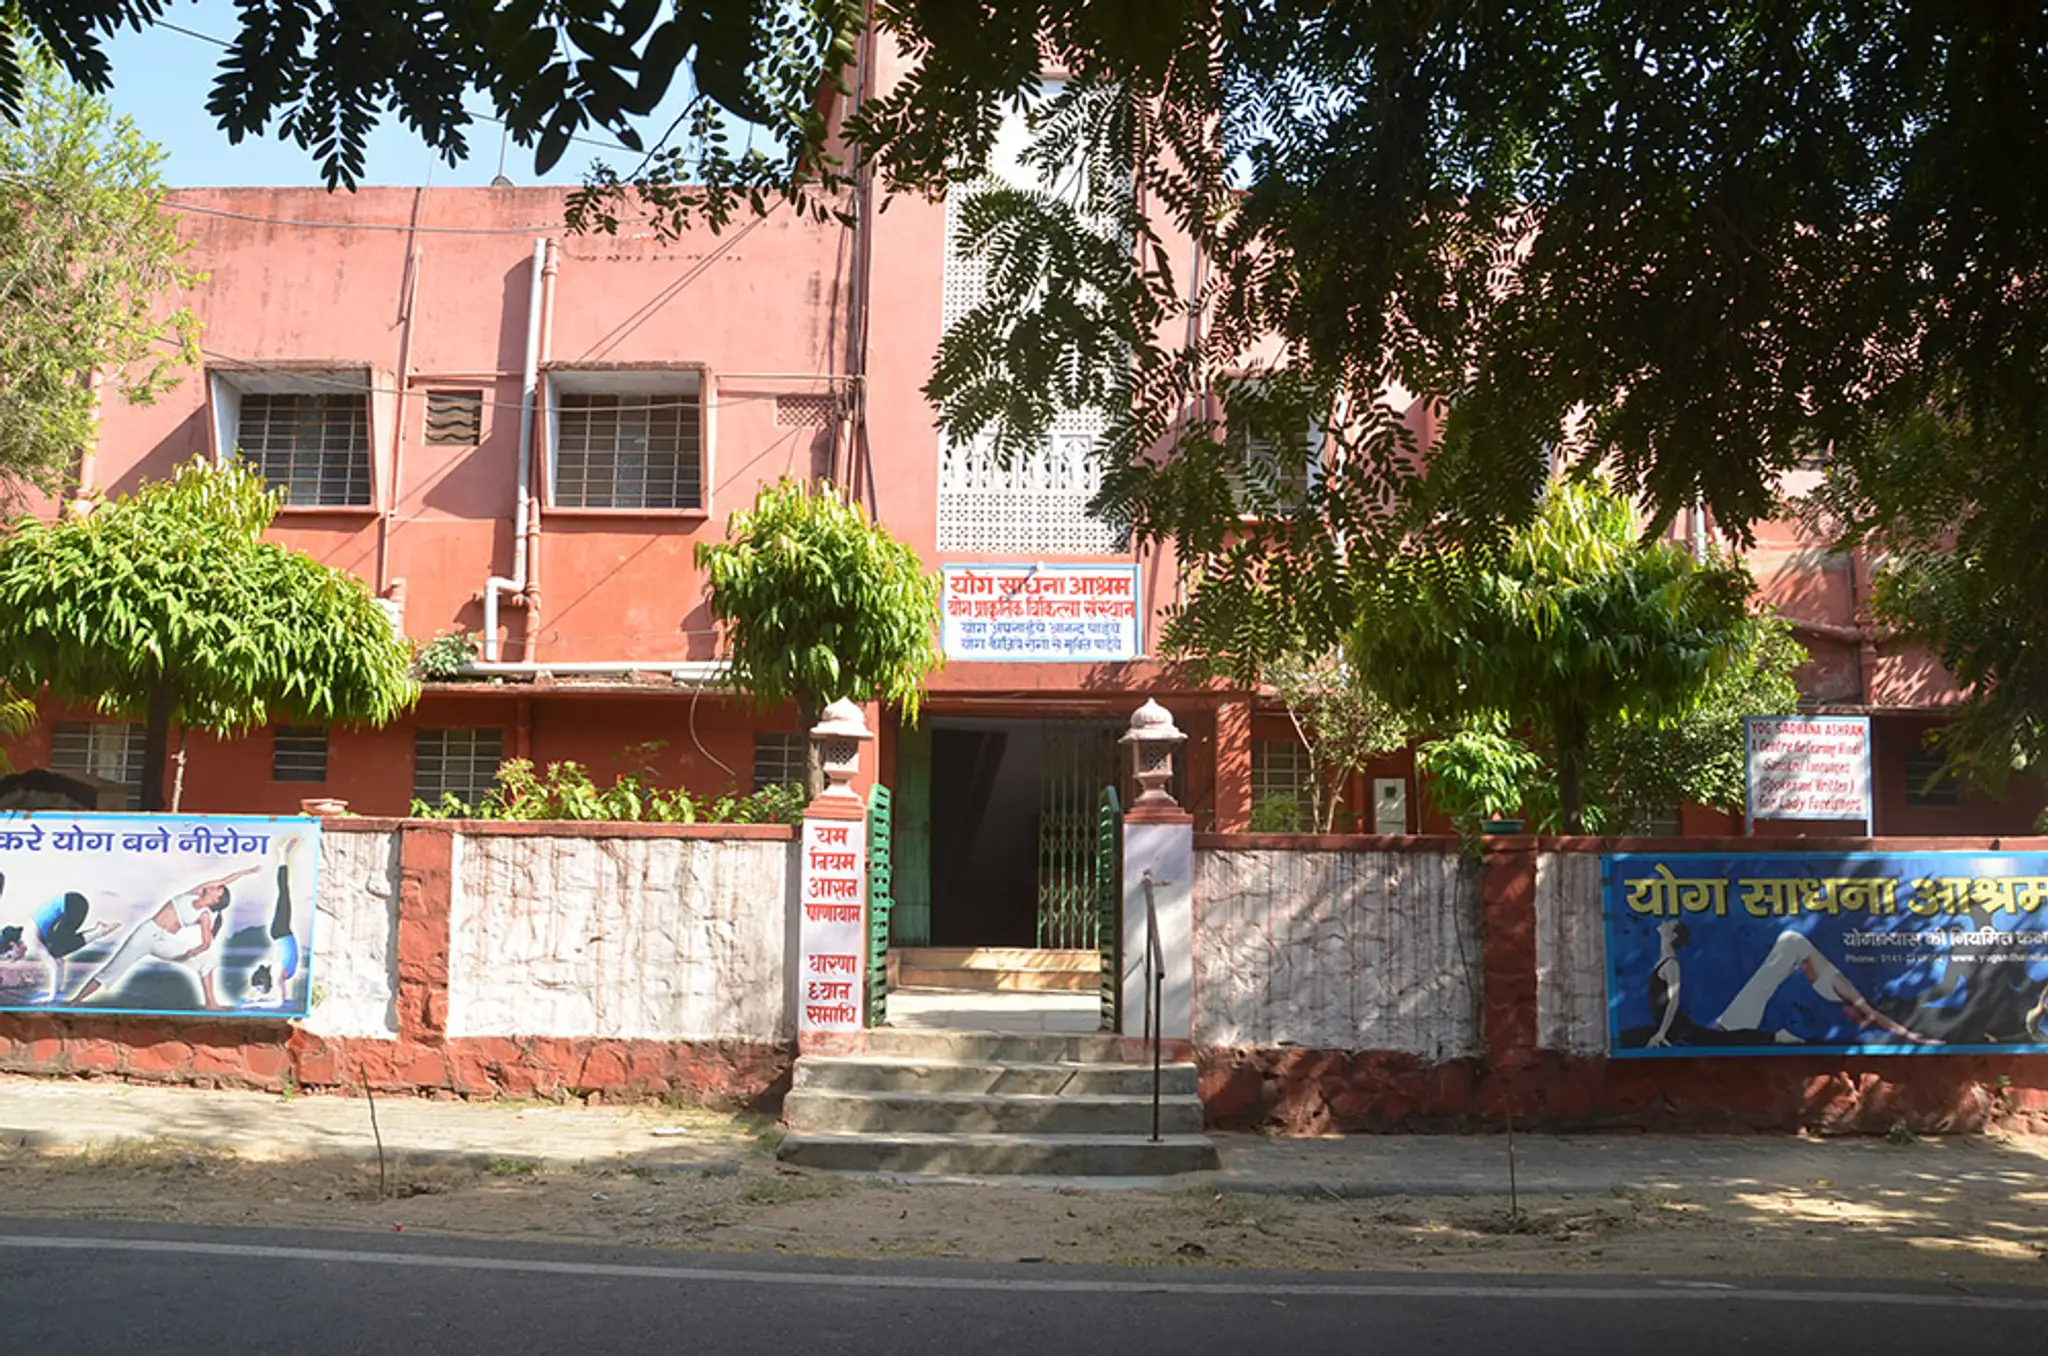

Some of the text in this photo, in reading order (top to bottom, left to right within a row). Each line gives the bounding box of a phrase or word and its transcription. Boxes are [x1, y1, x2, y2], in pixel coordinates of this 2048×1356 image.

[950, 569, 1131, 596] योग साधना आश्रम
[947, 595, 1135, 621] योग प्राकृतिक चिकित्सा संस्थान
[960, 620, 986, 634] योग
[960, 635, 986, 650] योग
[1751, 722, 1865, 736] YOG SADHANA ASHRAM
[1760, 740, 1793, 752] Centre
[0, 824, 270, 855] करे योग बने नीरोग
[814, 827, 848, 846] यम
[809, 846, 856, 871] नियम
[808, 877, 858, 899] आसन
[1624, 863, 2048, 917] योग साधना आश्रम
[1950, 926, 2013, 947] नियमित
[809, 954, 857, 974] धारणा
[808, 981, 852, 1001] ध्यान
[806, 1003, 857, 1026] समाधि
